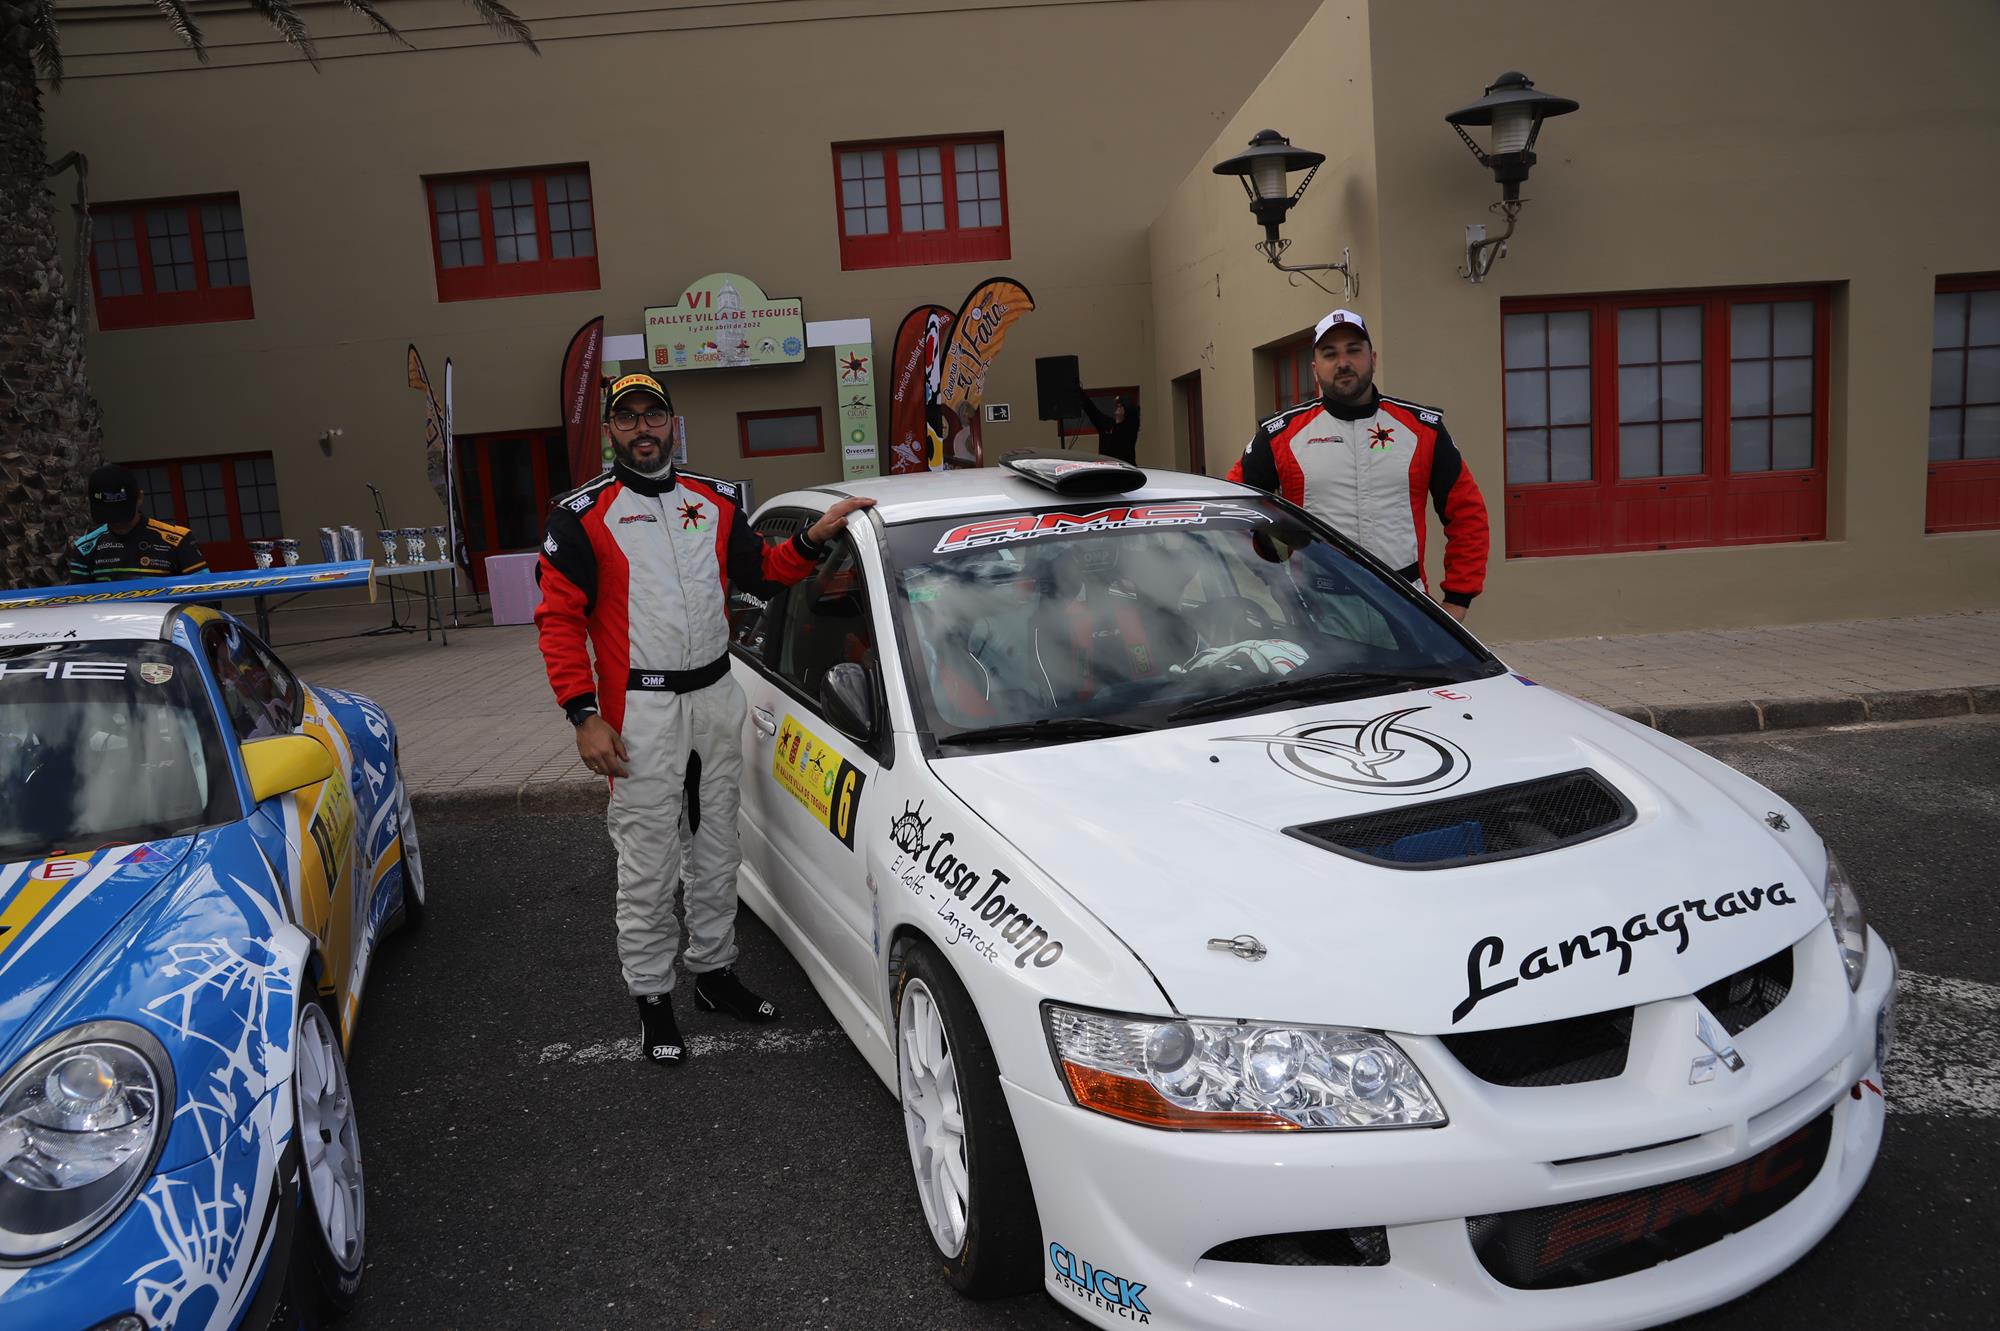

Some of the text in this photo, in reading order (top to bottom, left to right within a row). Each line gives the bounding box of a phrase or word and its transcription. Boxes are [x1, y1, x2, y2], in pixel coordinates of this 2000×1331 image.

[686, 291, 711, 309] VI
[650, 307, 799, 325] RALLYE VILLA DE TEGUISE
[961, 303, 1002, 357] Faro
[571, 329, 598, 424] Servicio Insular de Deportes
[894, 370, 911, 402] Servicio
[906, 347, 922, 374] Insular
[1267, 419, 1286, 433] OMP
[1419, 412, 1439, 424] OMP
[717, 484, 735, 495] OMP
[571, 495, 592, 511] OMP
[543, 538, 558, 554] MP
[641, 675, 666, 688] OMP
[837, 769, 857, 839] 6
[43, 861, 77, 879] E
[925, 832, 981, 901] Casa
[890, 855, 905, 875] El
[901, 866, 925, 895] Golfo
[937, 898, 998, 963] Lanzarote
[1451, 881, 1796, 1025] Lanzagrava
[652, 1047, 682, 1057] OMP
[1049, 1241, 1152, 1315] CLICK
[1055, 1273, 1150, 1325] ASISTENCIA
